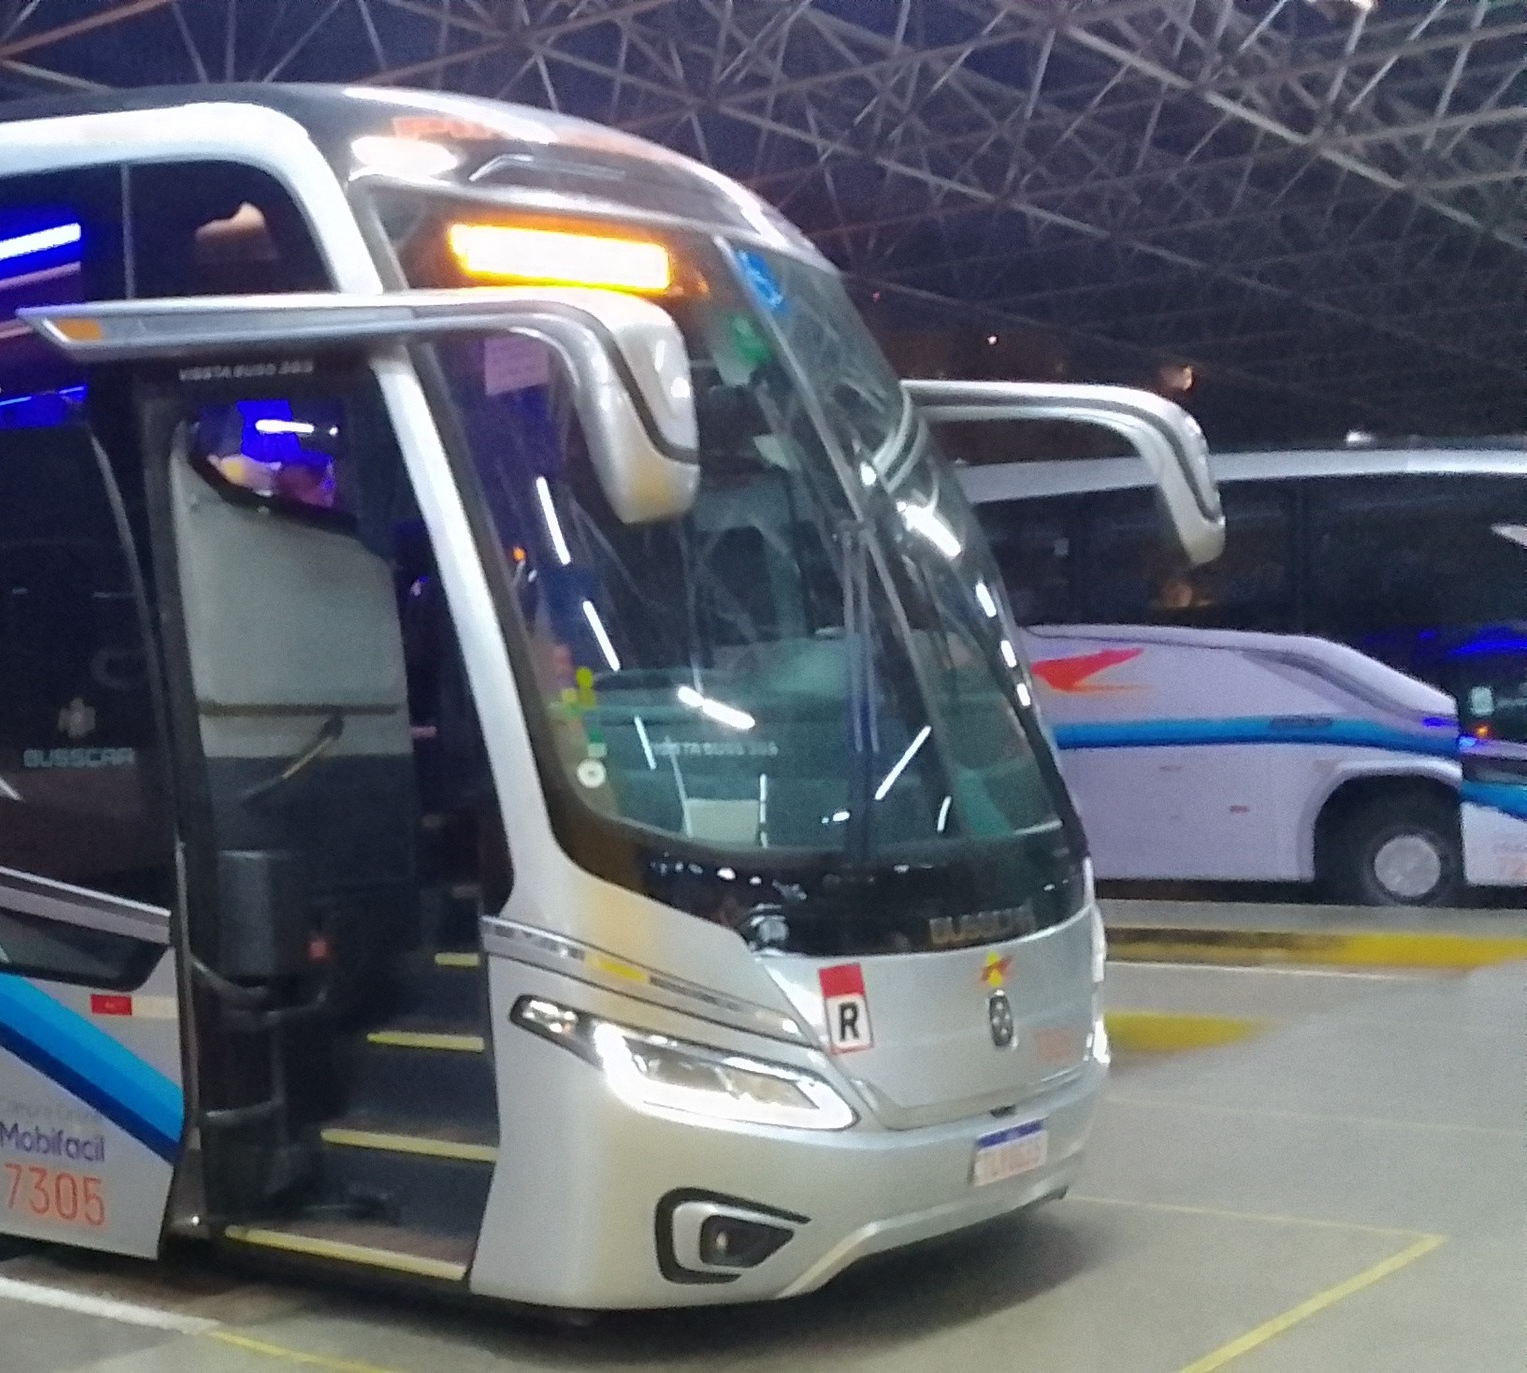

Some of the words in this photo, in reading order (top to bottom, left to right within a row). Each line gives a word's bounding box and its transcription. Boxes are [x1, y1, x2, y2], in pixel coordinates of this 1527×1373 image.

[23, 747, 135, 768] BUSSCAR
[839, 1001, 859, 1041] R
[5, 1162, 106, 1226] 7305
